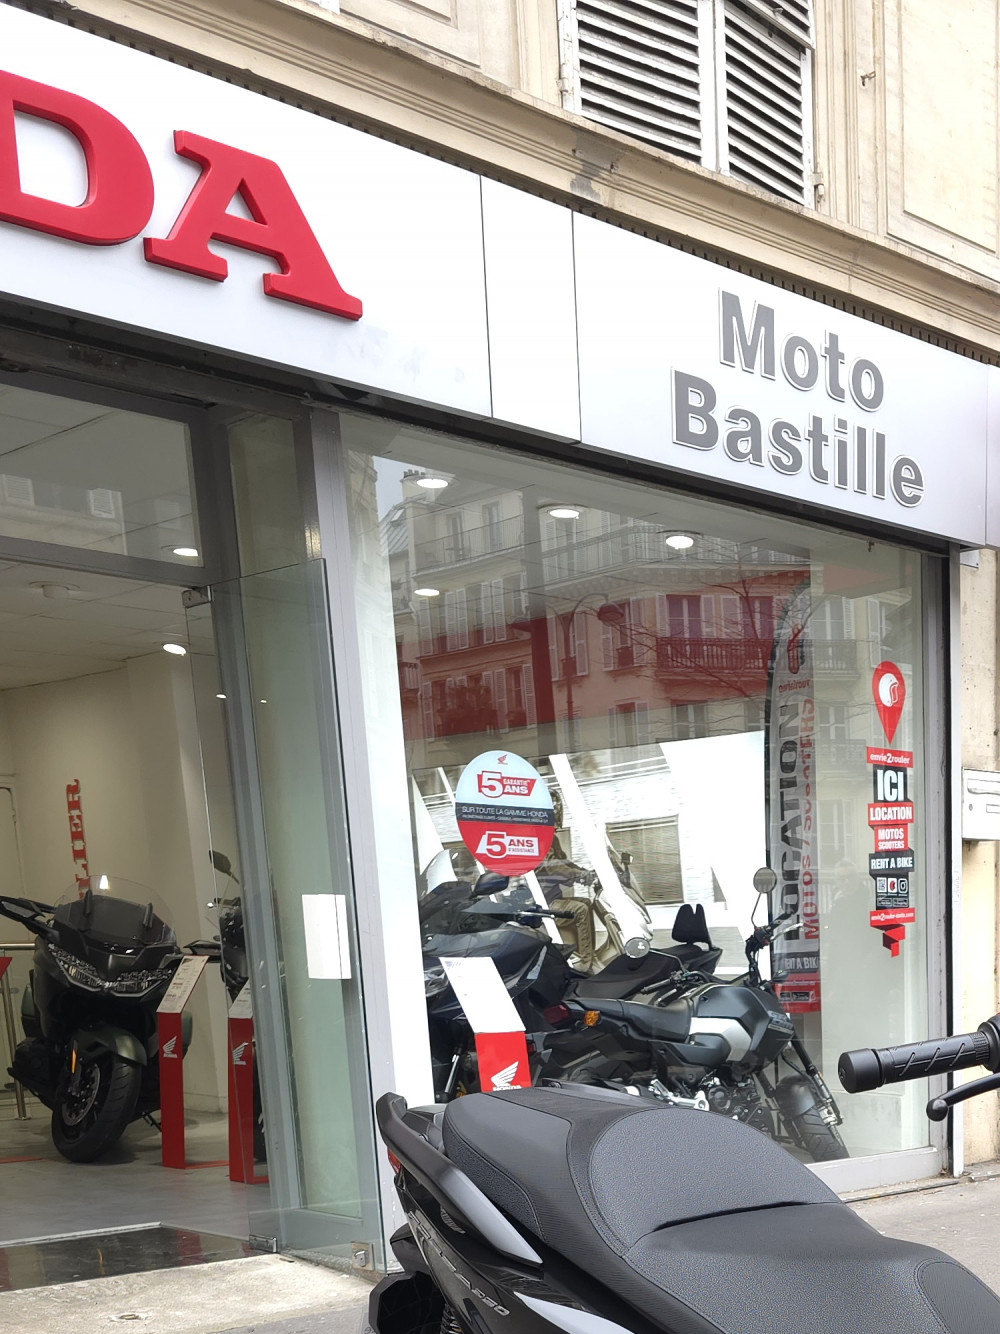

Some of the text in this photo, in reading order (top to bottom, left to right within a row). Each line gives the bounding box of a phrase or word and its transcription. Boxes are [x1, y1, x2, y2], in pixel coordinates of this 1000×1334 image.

[718, 286, 885, 412] Moto
[671, 365, 925, 508] Bastille
[481, 771, 504, 798] 5
[504, 785, 528, 794] ANS
[876, 769, 905, 802] ICI
[504, 809, 527, 817] GAMME
[869, 806, 913, 821] LOCATION
[66, 778, 91, 899] LIER
[485, 831, 534, 858] 5 ANS
[878, 827, 905, 840] MOTOS
[878, 840, 905, 850] SCOOTERS
[871, 856, 913, 870] RENT A BIKE
[802, 854, 819, 940] MOTOS
